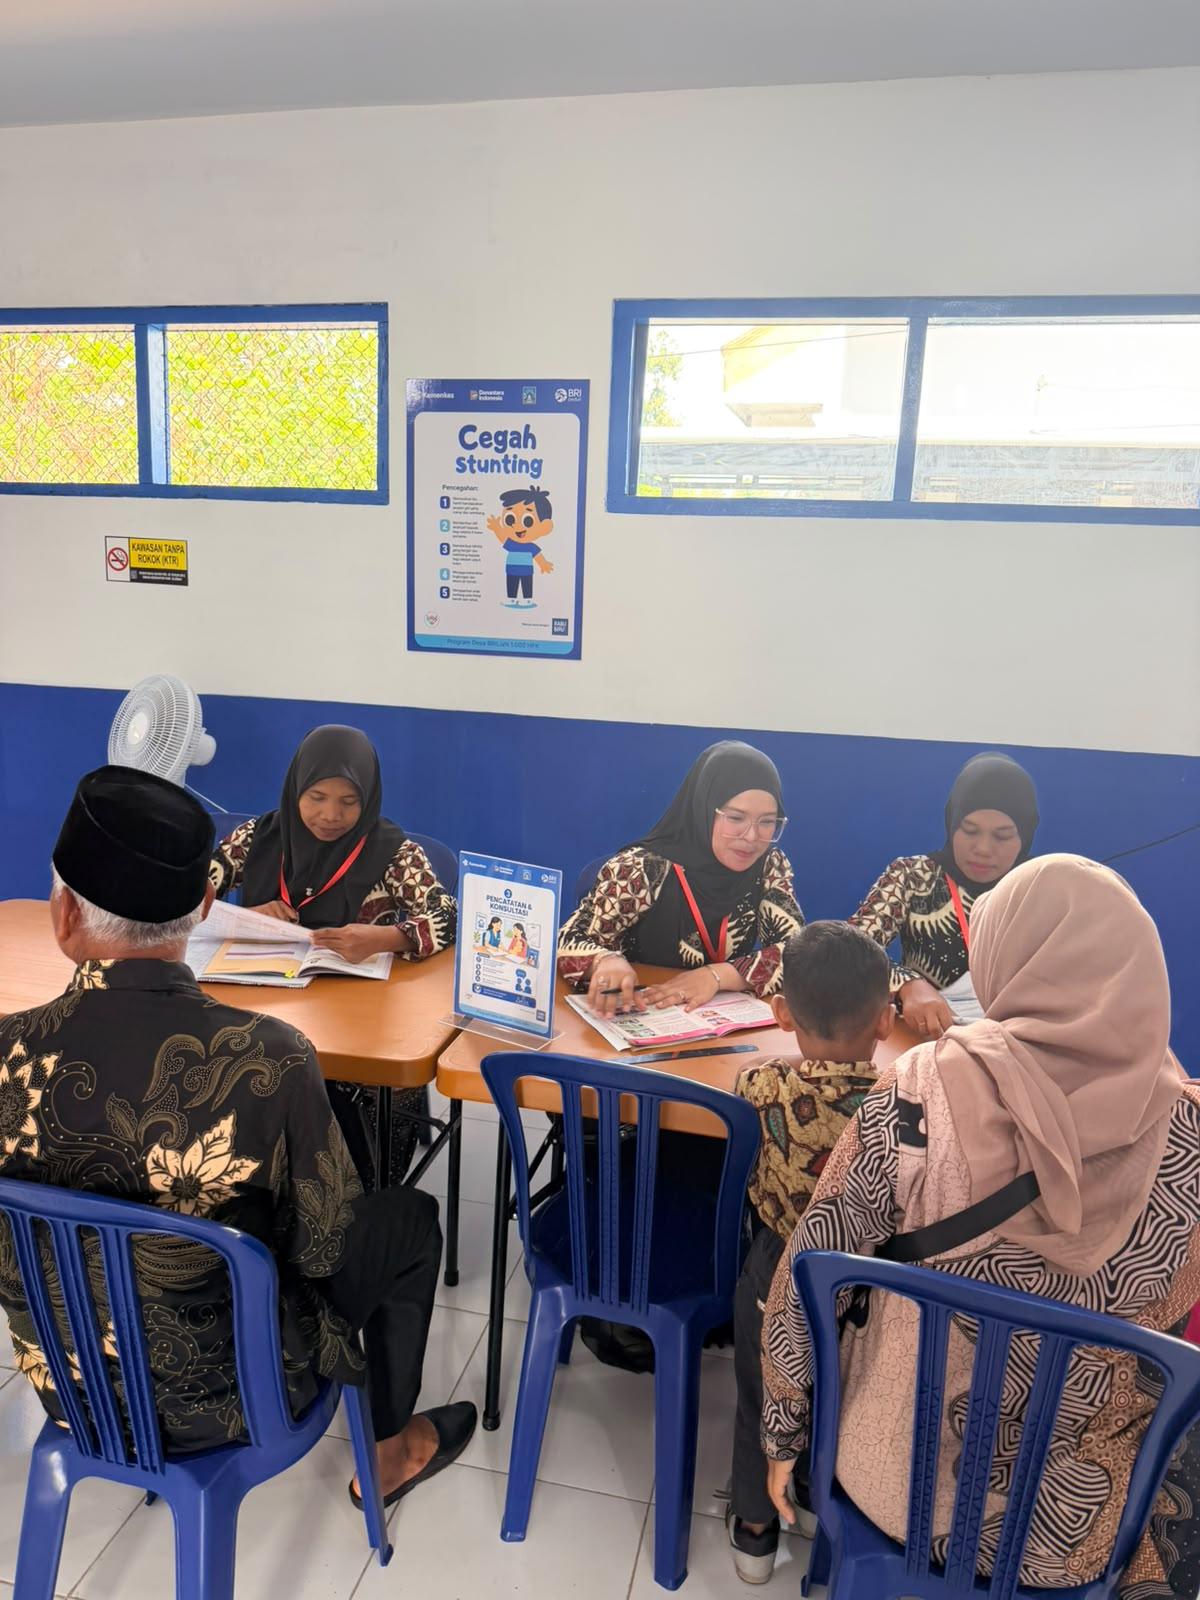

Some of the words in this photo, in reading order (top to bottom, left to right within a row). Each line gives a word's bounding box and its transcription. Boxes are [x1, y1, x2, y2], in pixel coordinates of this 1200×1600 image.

[568, 388, 582, 398] BRI
[458, 424, 537, 453] Cegah
[455, 454, 544, 479] stunting
[442, 484, 479, 492] Pencegahan:
[132, 543, 163, 553] KAWASAN
[164, 544, 185, 553] TANPA
[138, 554, 161, 564] ROKOK
[162, 555, 179, 567] (KTR)
[447, 638, 471, 647] Program
[486, 895, 527, 909] PENCATATAN
[489, 903, 529, 917] KONSULTASI
